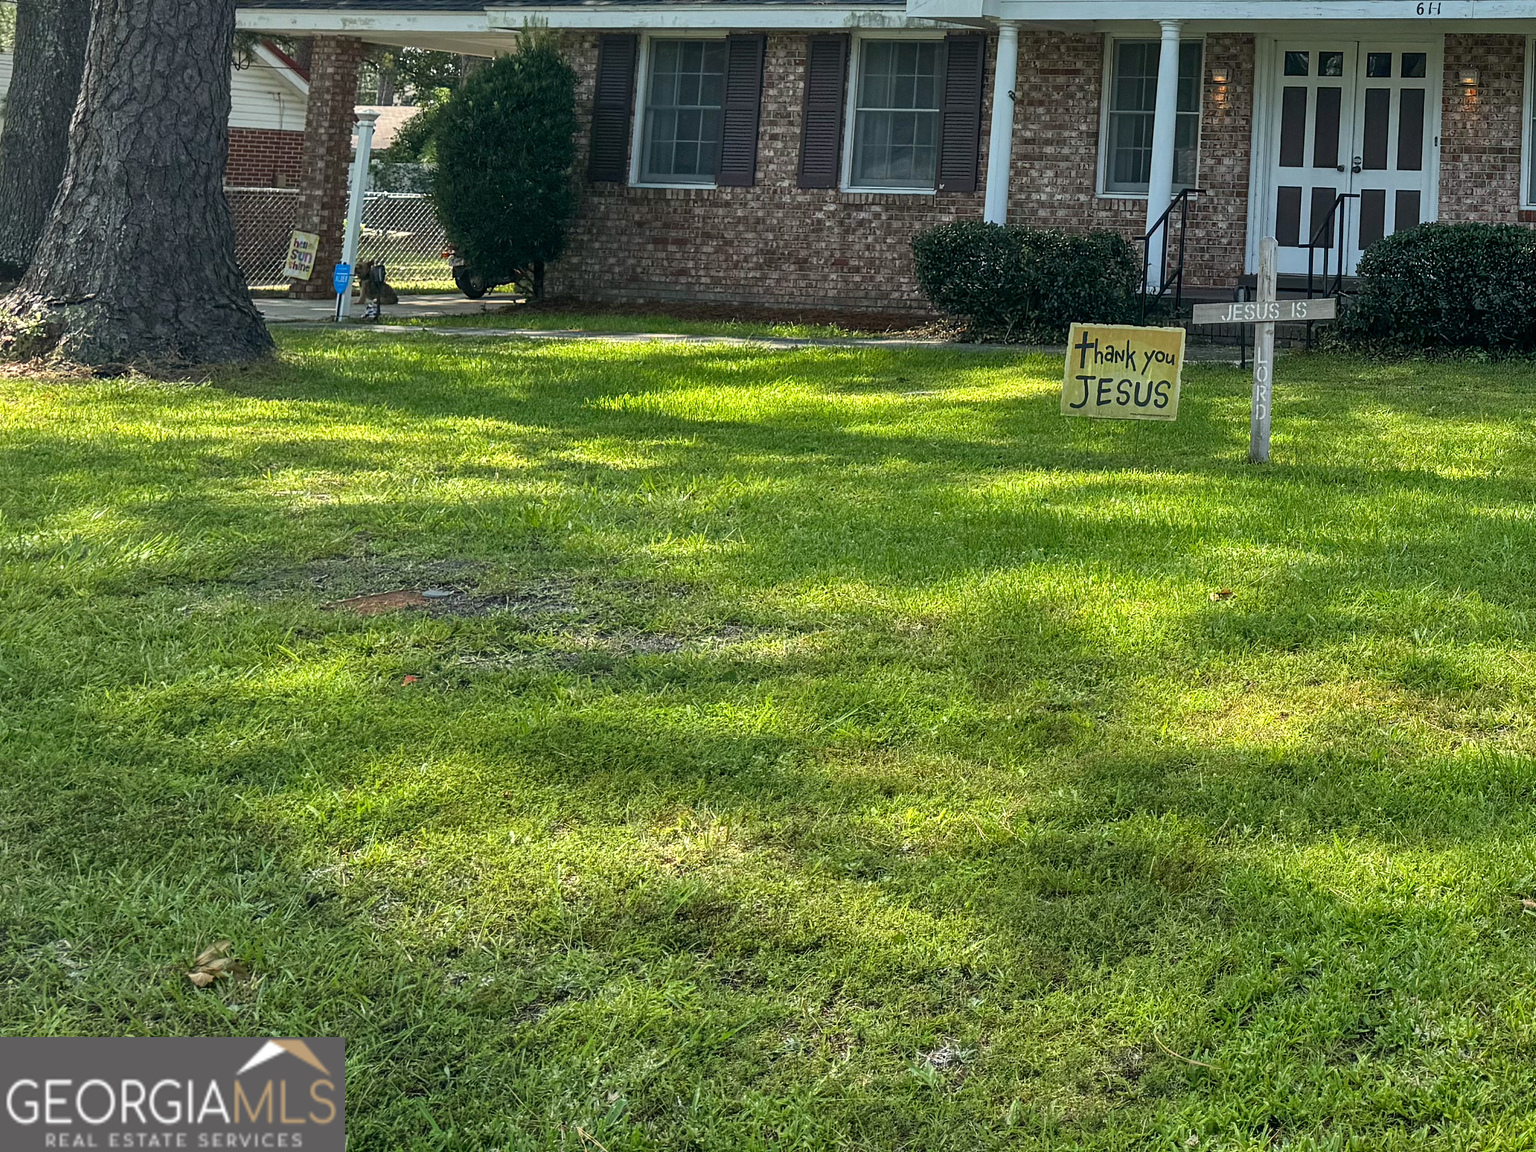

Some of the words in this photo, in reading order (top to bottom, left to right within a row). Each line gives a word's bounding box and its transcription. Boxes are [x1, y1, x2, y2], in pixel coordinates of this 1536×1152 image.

[1416, 2, 1442, 15] 611
[291, 249, 312, 263] sun
[1221, 302, 1280, 321] JESUS
[1291, 301, 1307, 318] IS
[1141, 350, 1175, 375] you
[1069, 375, 1171, 408] JESUS
[1255, 347, 1268, 420] LORD
